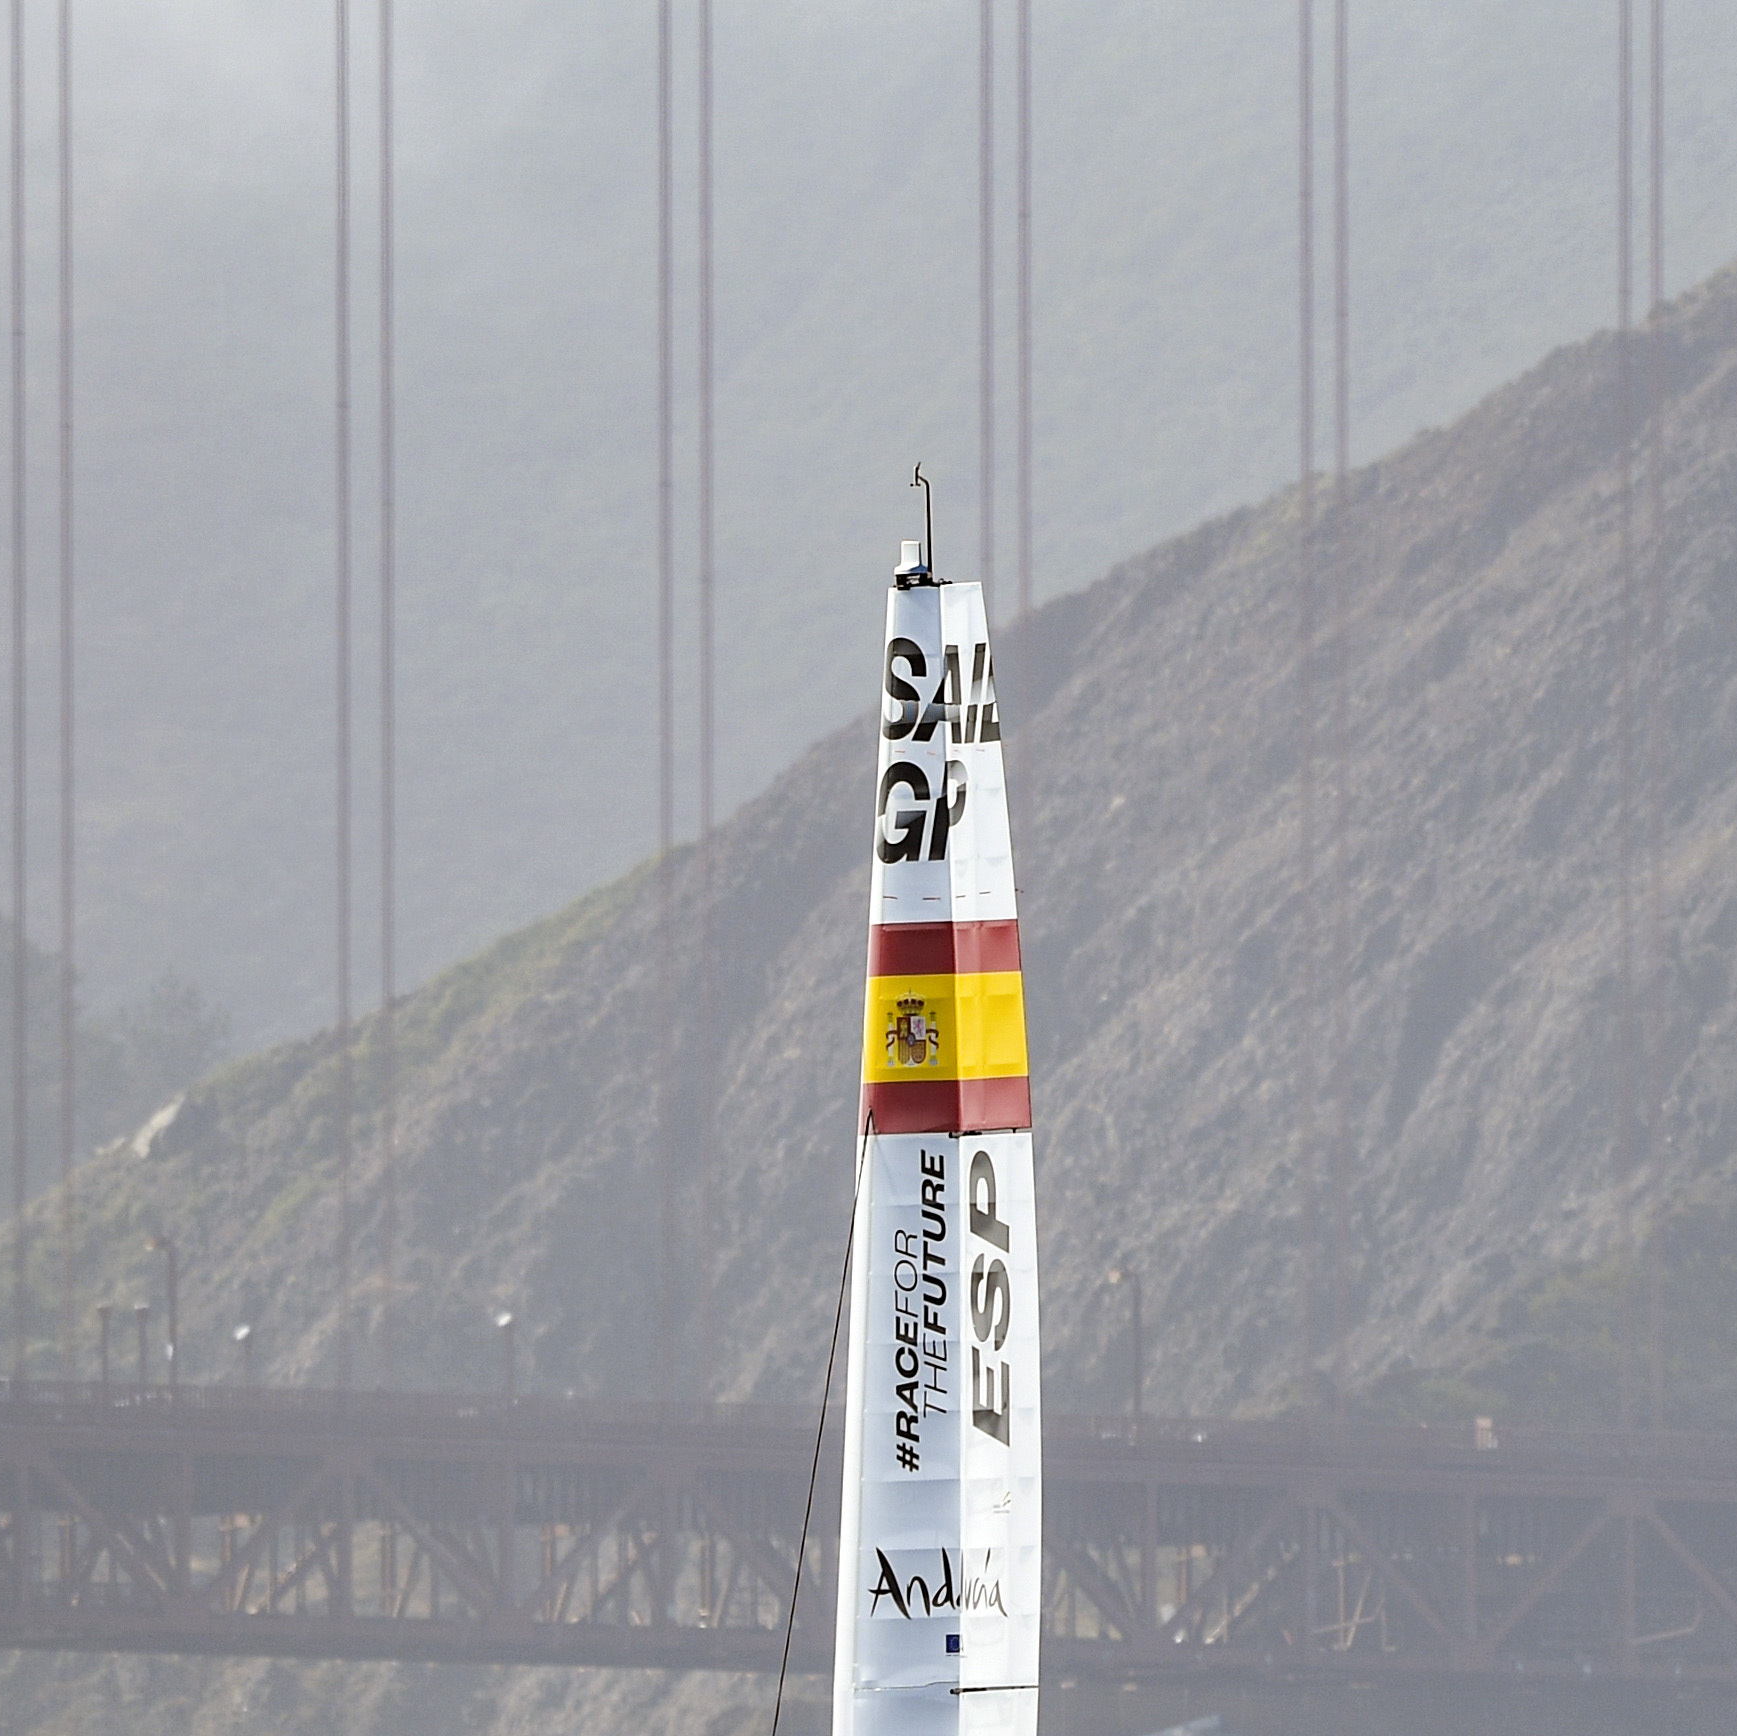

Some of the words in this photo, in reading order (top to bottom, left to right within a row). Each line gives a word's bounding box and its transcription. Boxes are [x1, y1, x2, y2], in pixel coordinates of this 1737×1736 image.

[875, 759, 969, 865] GP
[881, 636, 1002, 744] SAIL
[894, 1227, 921, 1474] #RACEFOR
[920, 1148, 949, 1418] THEFUTURE
[968, 1149, 1011, 1449] ESP
